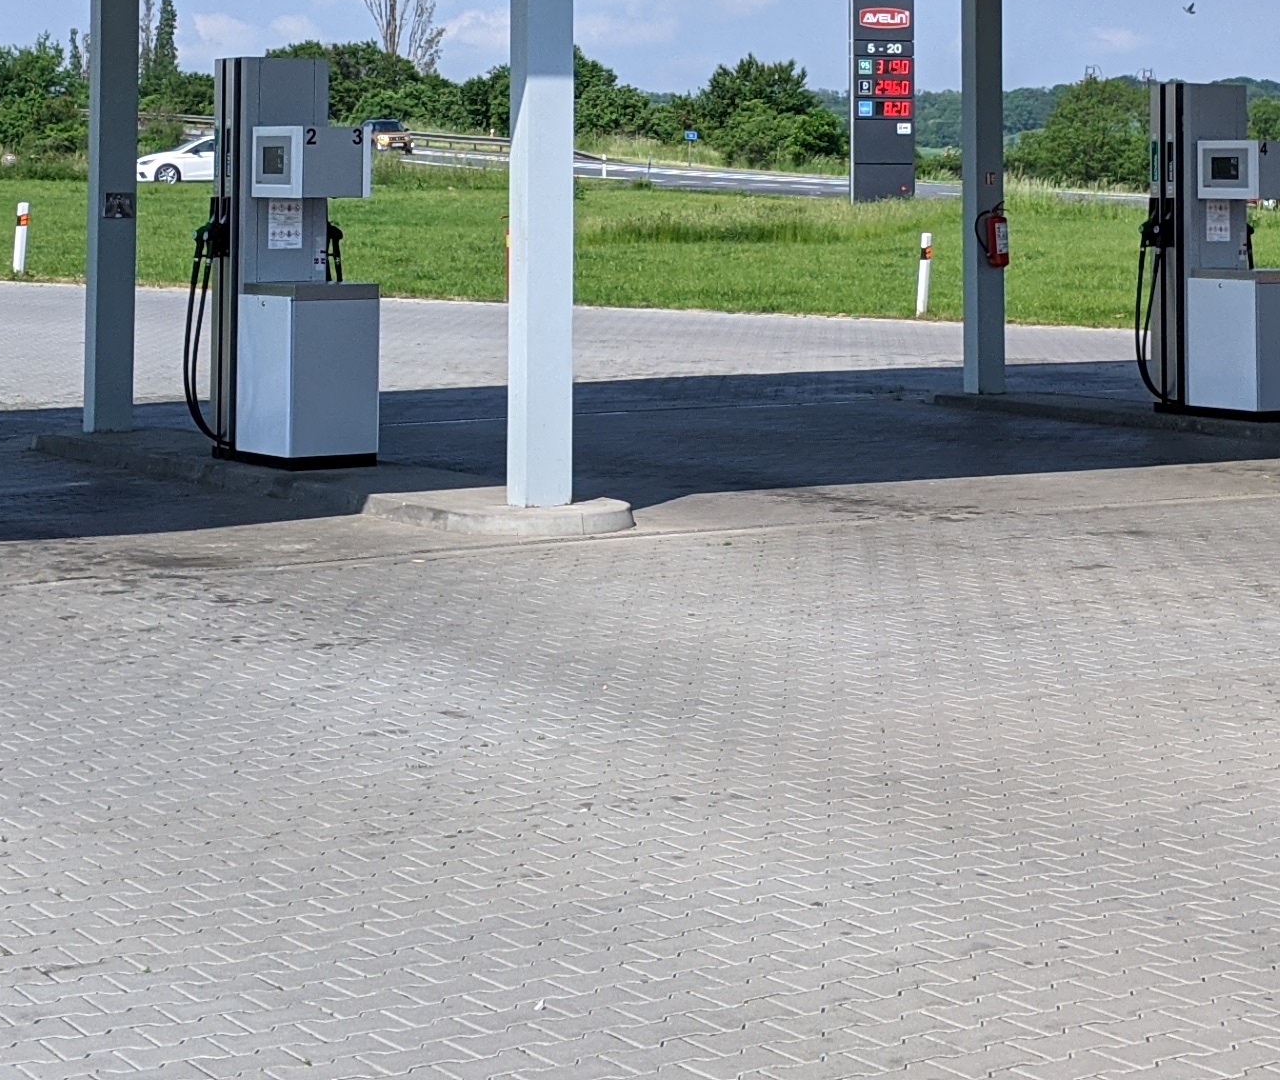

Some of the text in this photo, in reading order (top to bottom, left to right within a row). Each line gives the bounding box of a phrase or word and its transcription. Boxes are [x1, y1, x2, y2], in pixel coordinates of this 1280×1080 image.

[867, 43, 875, 53] 5
[886, 43, 902, 54] 20
[860, 61, 870, 69] 95
[862, 81, 869, 90] D
[306, 128, 317, 145] 2
[352, 128, 363, 145] 3
[1259, 142, 1268, 156] 4
